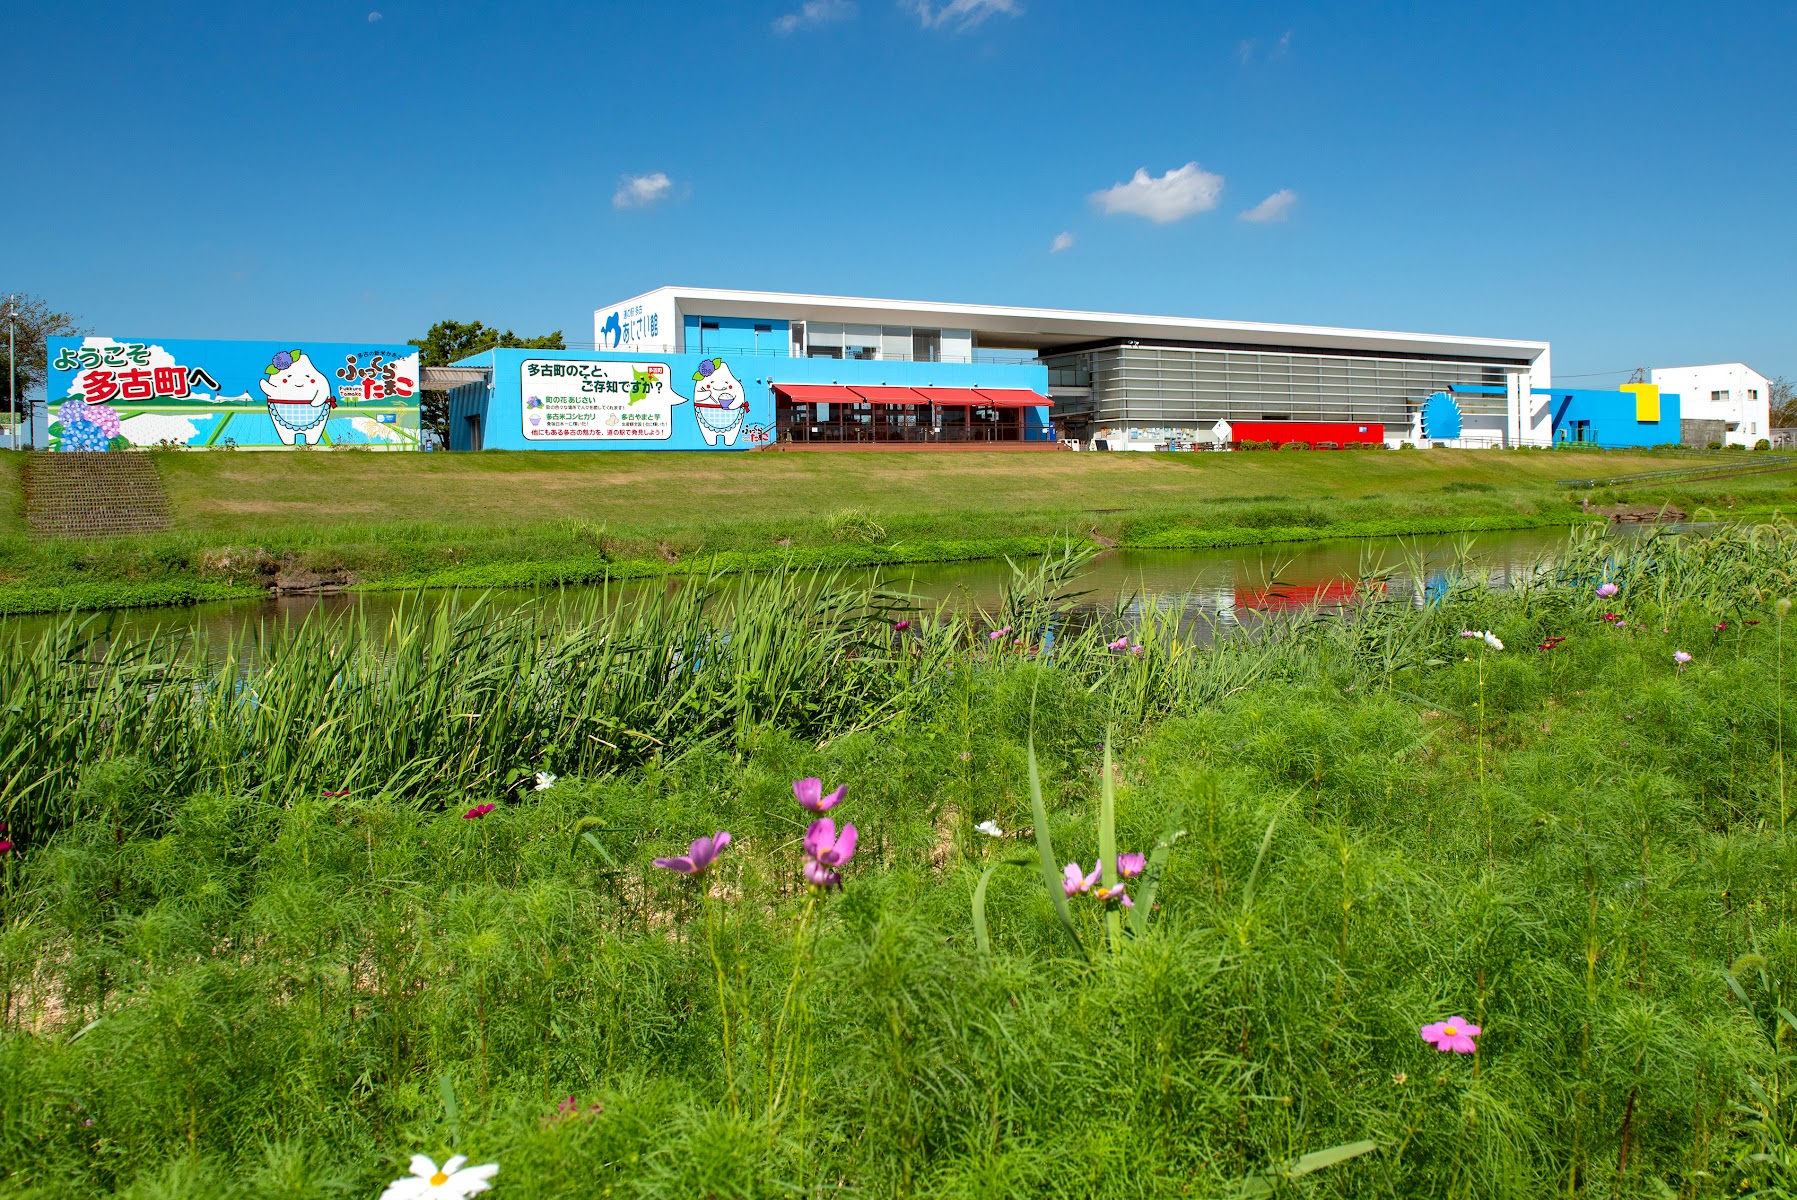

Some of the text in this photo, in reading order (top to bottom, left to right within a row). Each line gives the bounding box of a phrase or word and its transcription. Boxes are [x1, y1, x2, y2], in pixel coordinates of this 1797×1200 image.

[622, 313, 658, 344] あじさい館
[53, 344, 150, 369] ようこそ
[336, 355, 397, 381] ふっくら
[528, 363, 608, 378] 多古町のこと、
[83, 366, 218, 404] 多古町へ
[361, 377, 414, 400] たまこ
[581, 380, 663, 394] ご存知ですか？
[545, 396, 596, 404] 町の花 あじさい
[546, 413, 596, 421] 多古米コシヒカリ
[621, 413, 661, 421] 多古やまと芋
